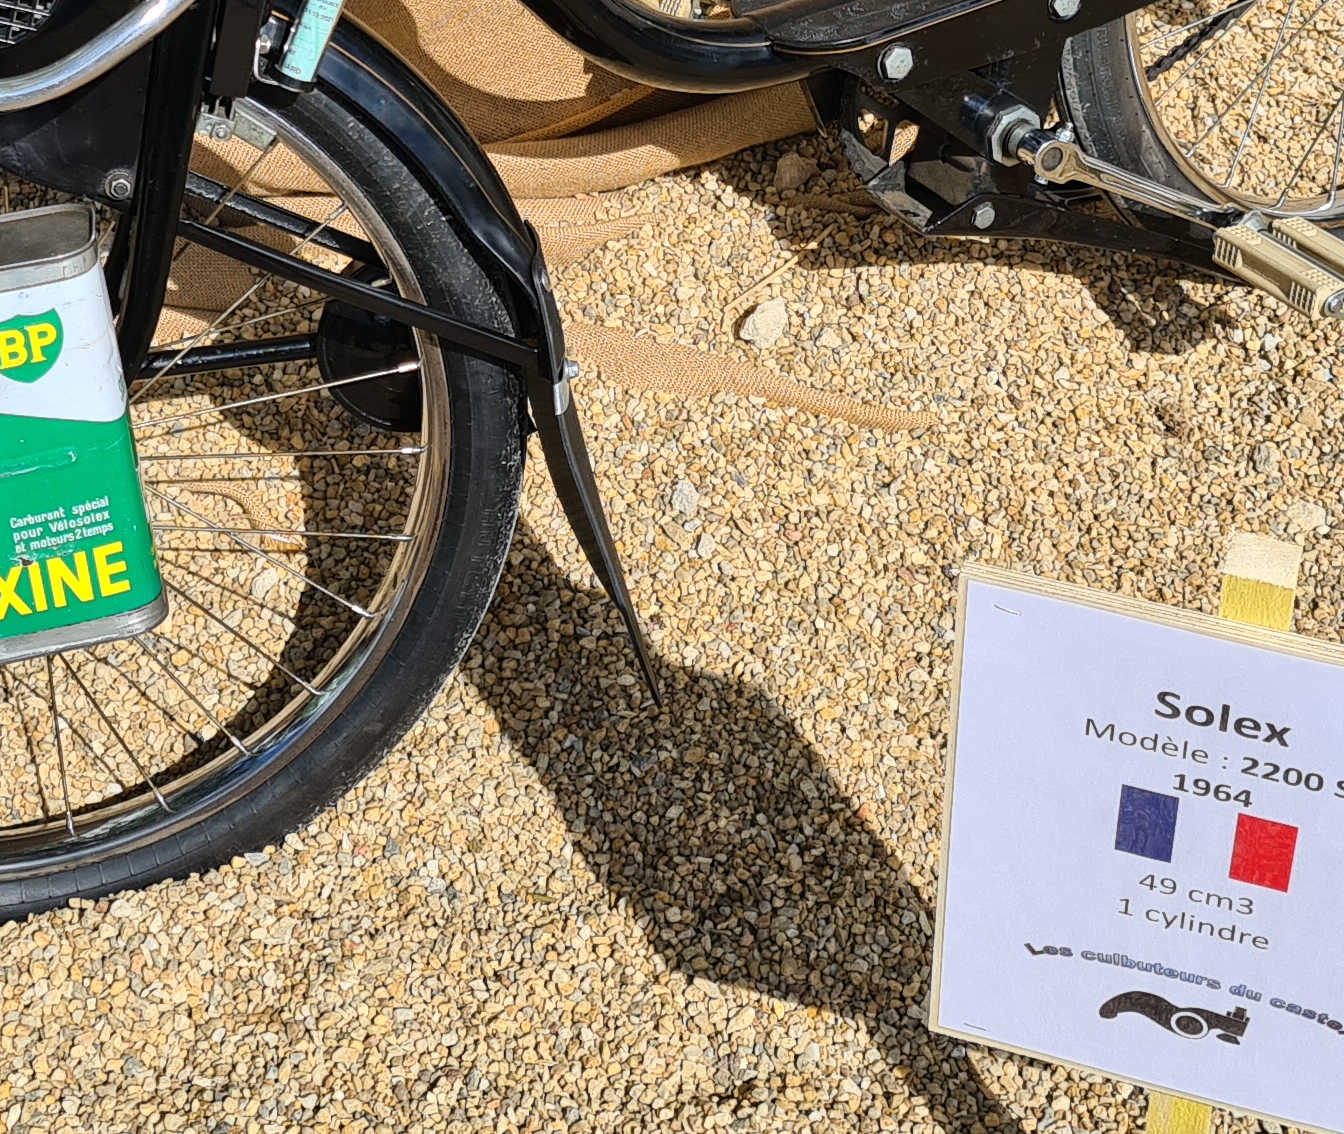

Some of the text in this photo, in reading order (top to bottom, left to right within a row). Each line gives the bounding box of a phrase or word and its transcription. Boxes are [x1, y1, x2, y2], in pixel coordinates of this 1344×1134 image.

[10, 495, 109, 528] Carburant spécial
[12, 510, 110, 543] pour Vélosolex
[15, 522, 114, 553] et moteurs 2 temps
[1154, 691, 1292, 748] Solex
[1085, 718, 1209, 764] Modèle
[1240, 756, 1325, 792] 2200
[1172, 773, 1253, 808] 1964
[1138, 874, 1254, 915] 49 cm3
[1117, 898, 1269, 950] 1 cylindre
[1024, 942, 1073, 957] Les
[1081, 948, 1221, 990] culbuteurs
[1229, 983, 1263, 1003] du
